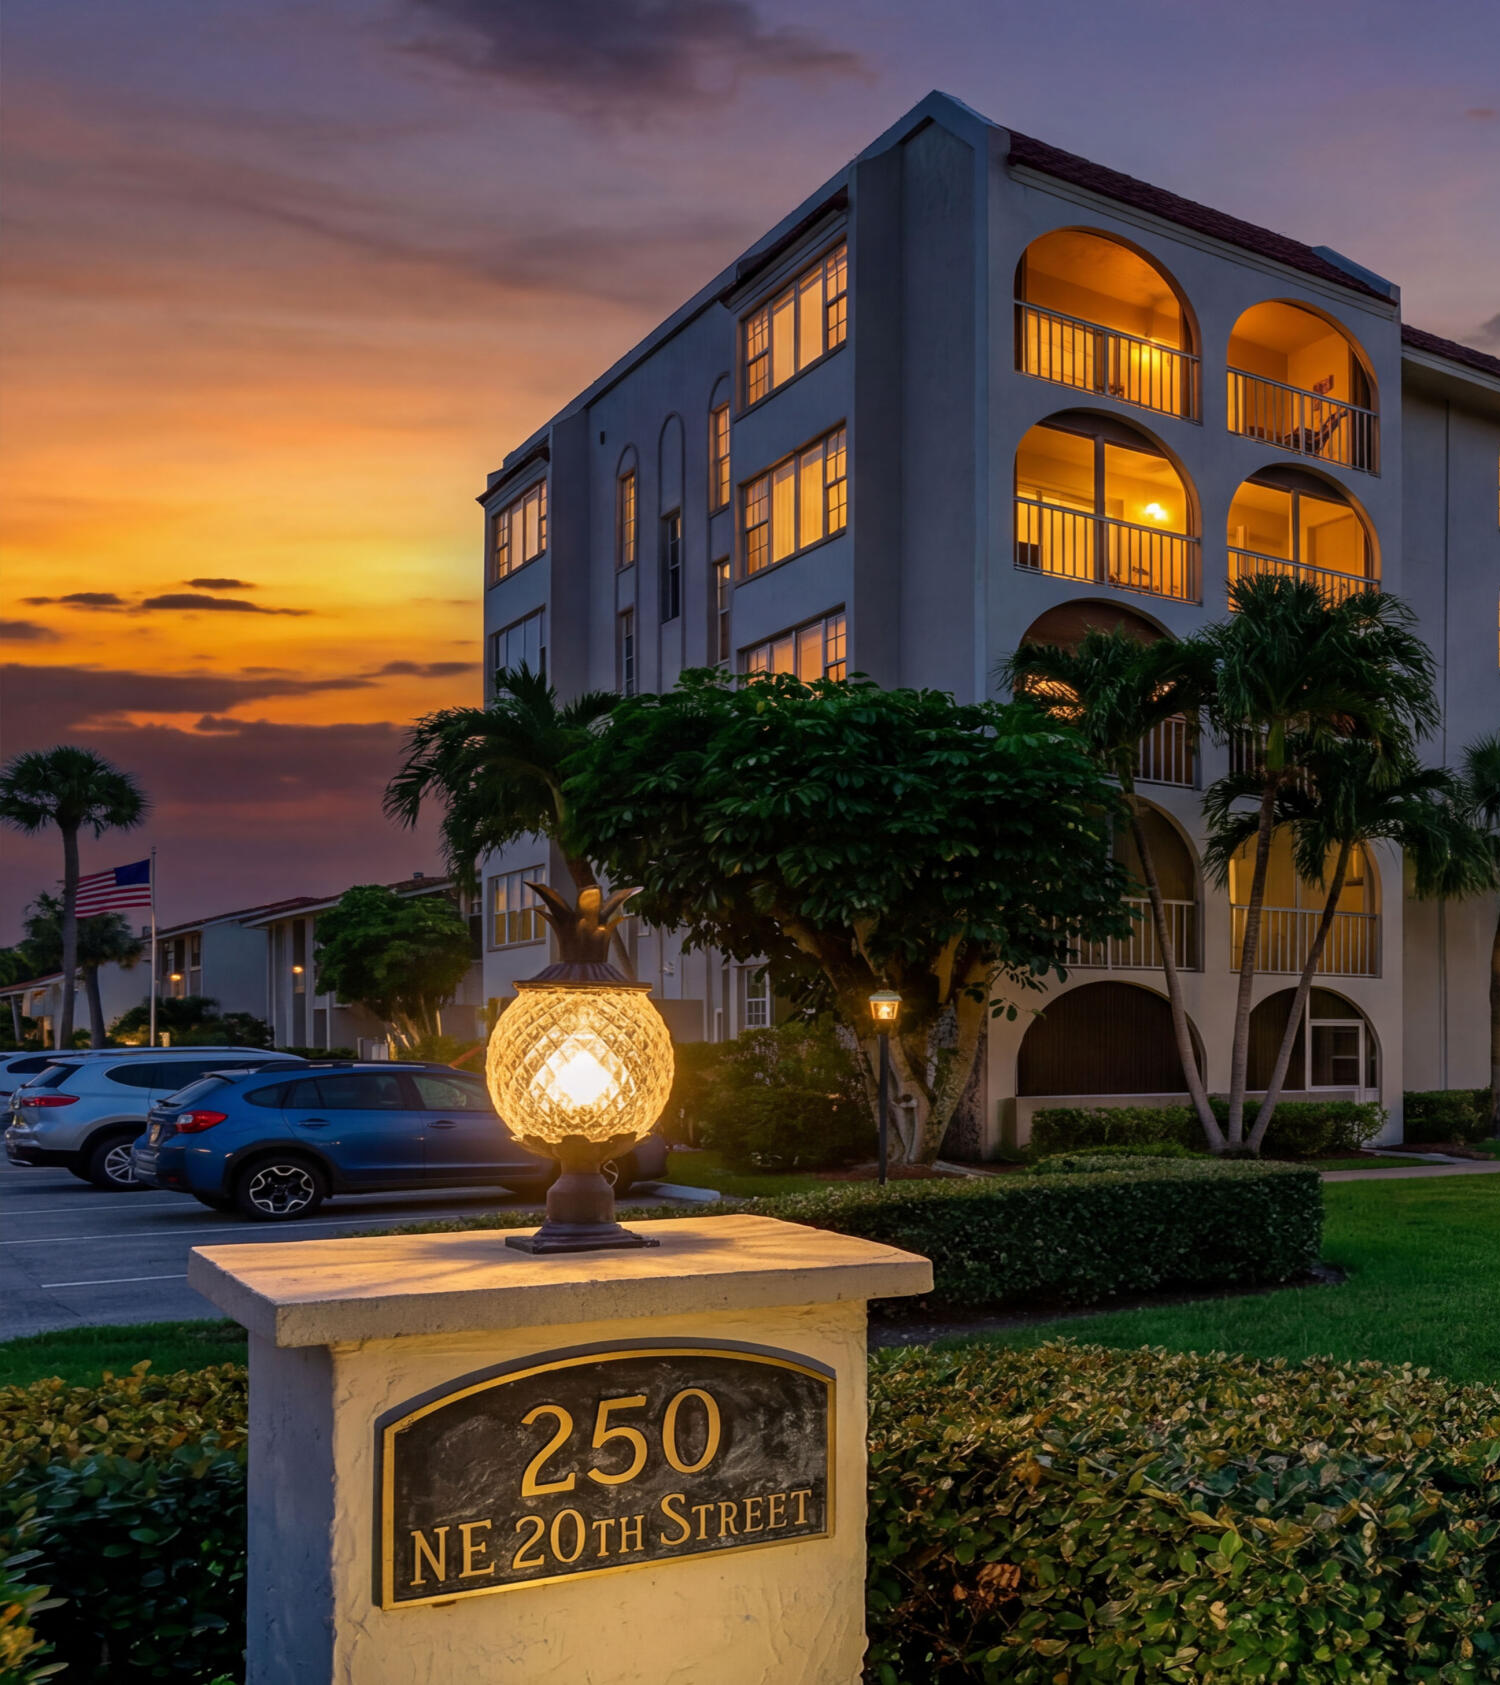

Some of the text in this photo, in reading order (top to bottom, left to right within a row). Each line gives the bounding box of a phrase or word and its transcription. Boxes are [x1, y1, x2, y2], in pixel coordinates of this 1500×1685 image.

[521, 1388, 722, 1497] 250
[409, 1489, 813, 1586] NE 20TH STREET
